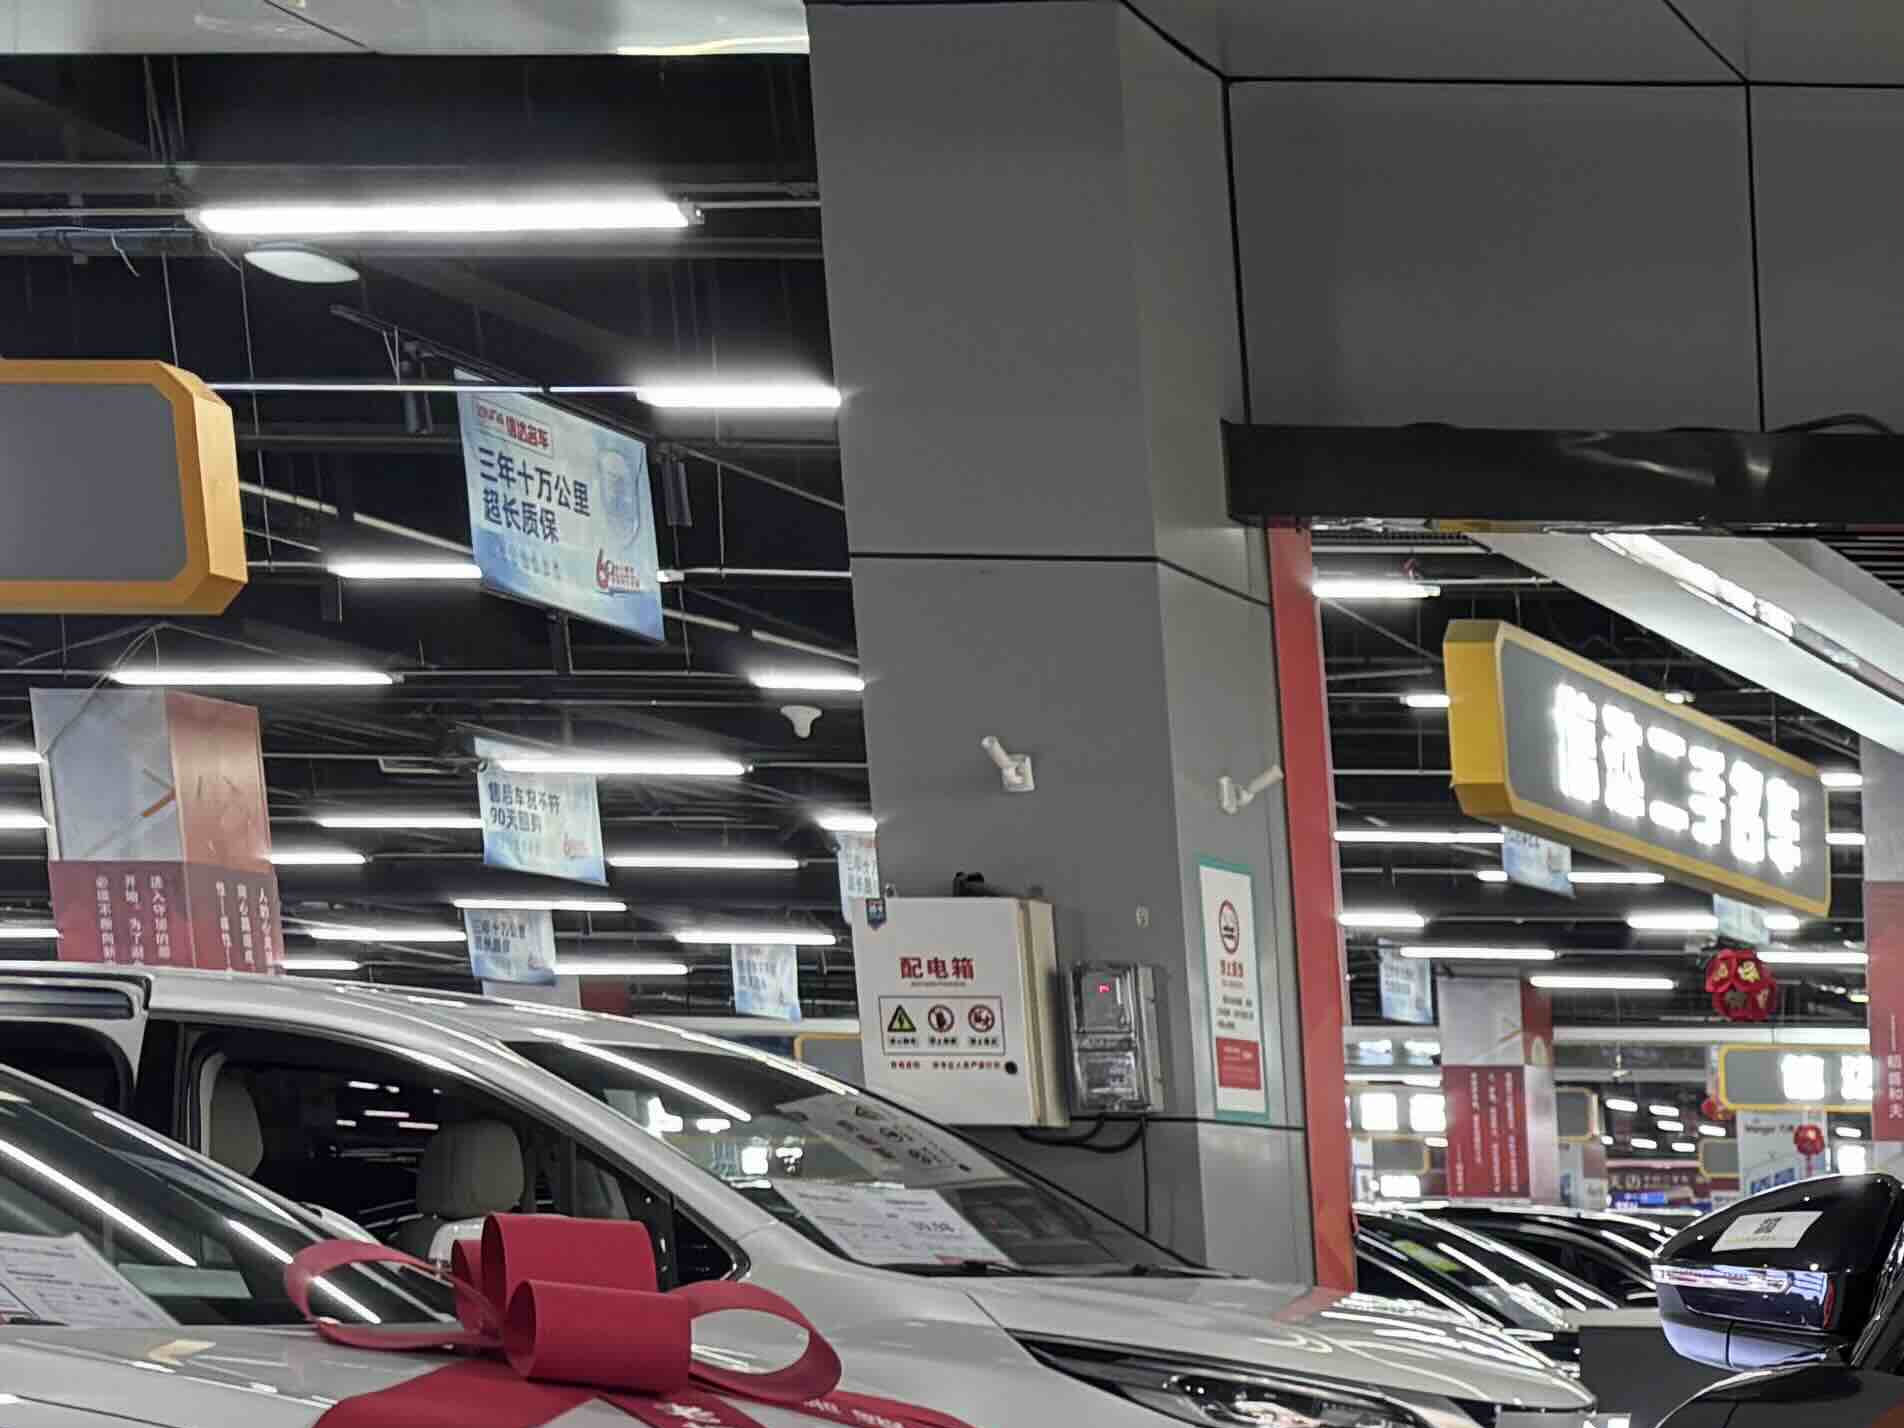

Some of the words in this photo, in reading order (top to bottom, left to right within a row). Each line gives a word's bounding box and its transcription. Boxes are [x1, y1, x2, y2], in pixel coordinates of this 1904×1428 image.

[479, 447, 591, 517] 三年十万公里
[483, 488, 560, 545] 超长质保
[899, 957, 975, 980] 配电箱
